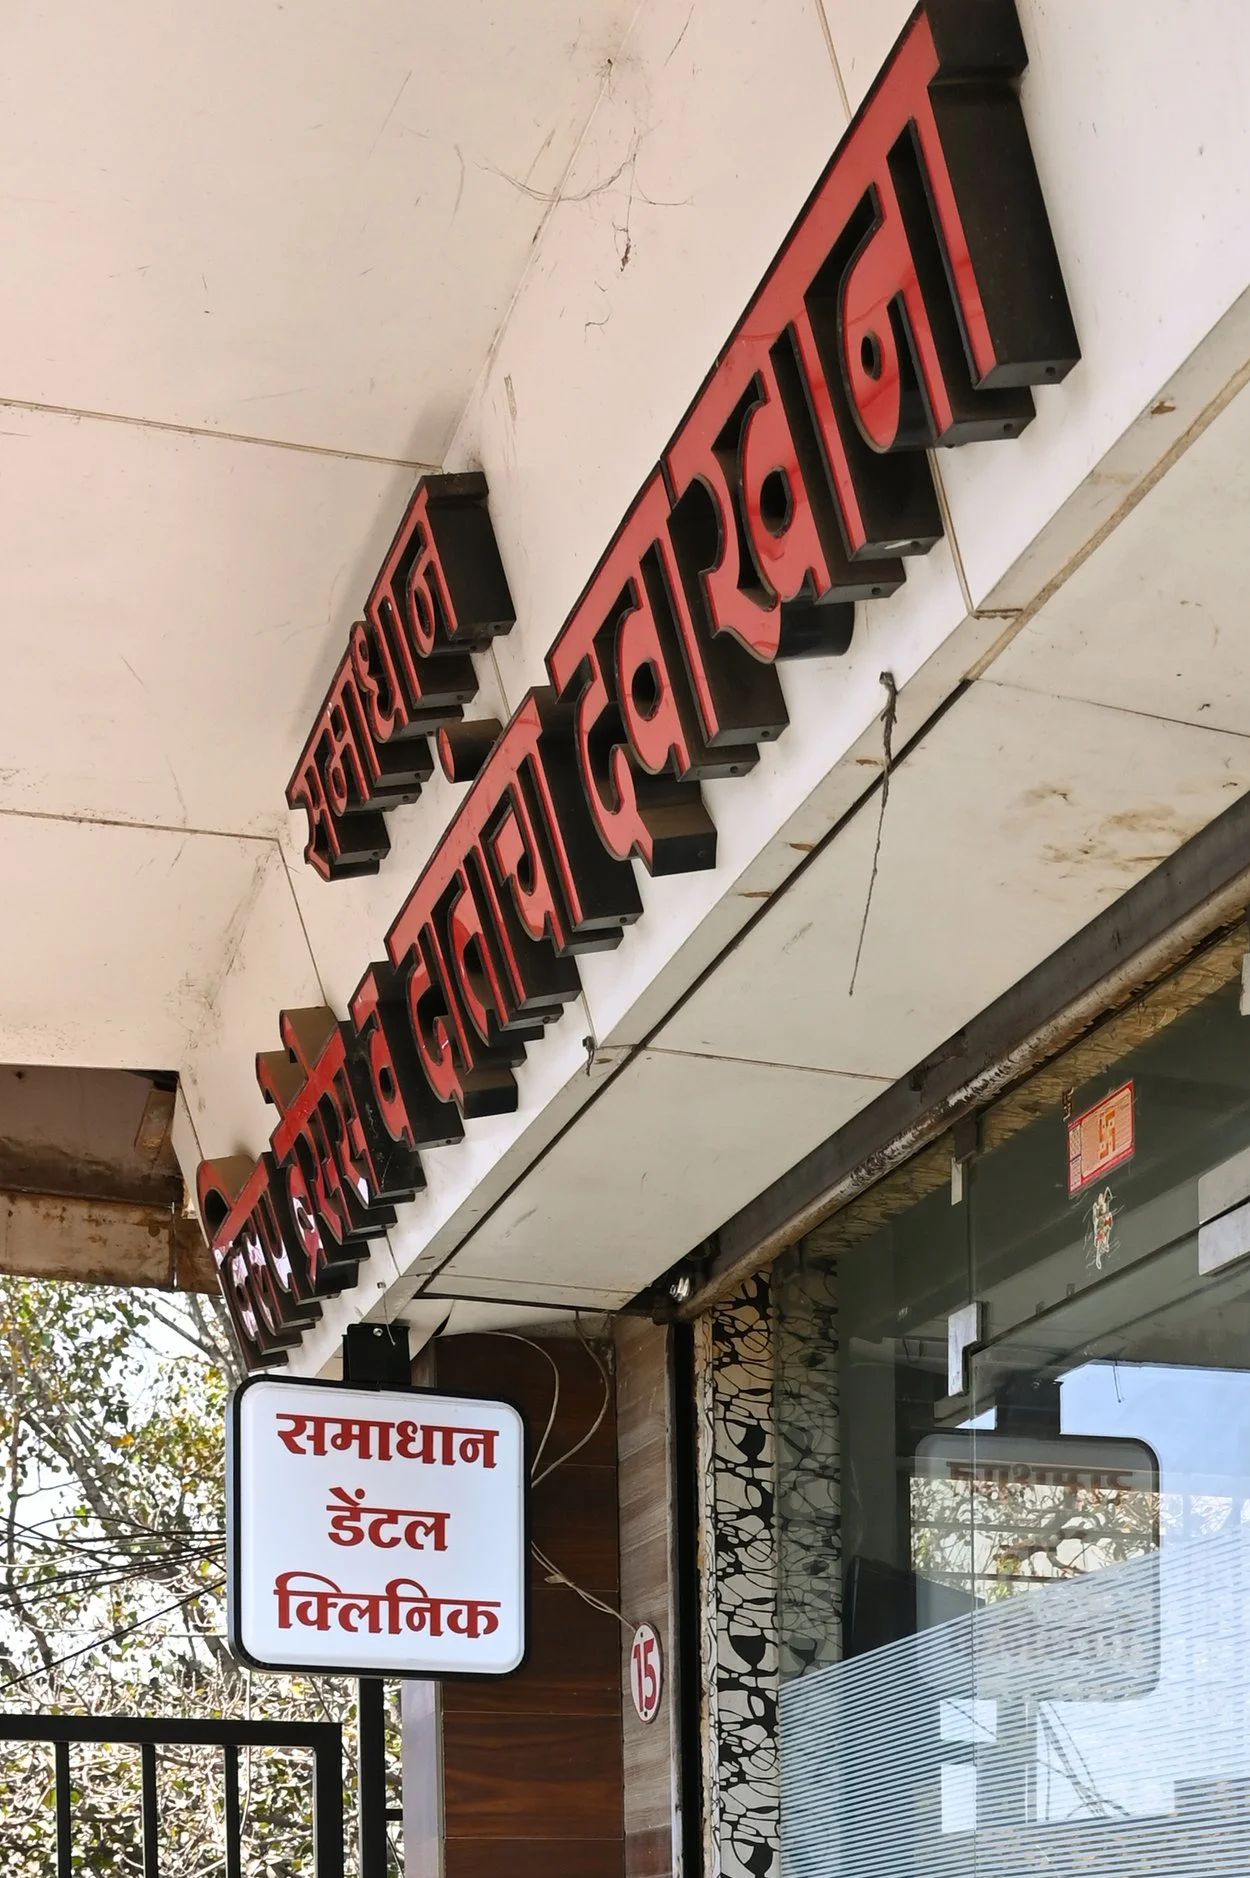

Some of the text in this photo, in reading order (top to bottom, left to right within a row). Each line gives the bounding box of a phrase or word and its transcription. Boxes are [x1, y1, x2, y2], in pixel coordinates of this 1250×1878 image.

[545, 0, 1045, 877] दवाखाना
[286, 473, 495, 882] समाधान
[384, 686, 615, 1112] दातांचा
[348, 964, 438, 1150] व
[275, 1412, 500, 1469] समाधान
[325, 1486, 451, 1552] डेंटल
[273, 1571, 502, 1639] क्लिनिक
[632, 1636, 656, 1713] 15
